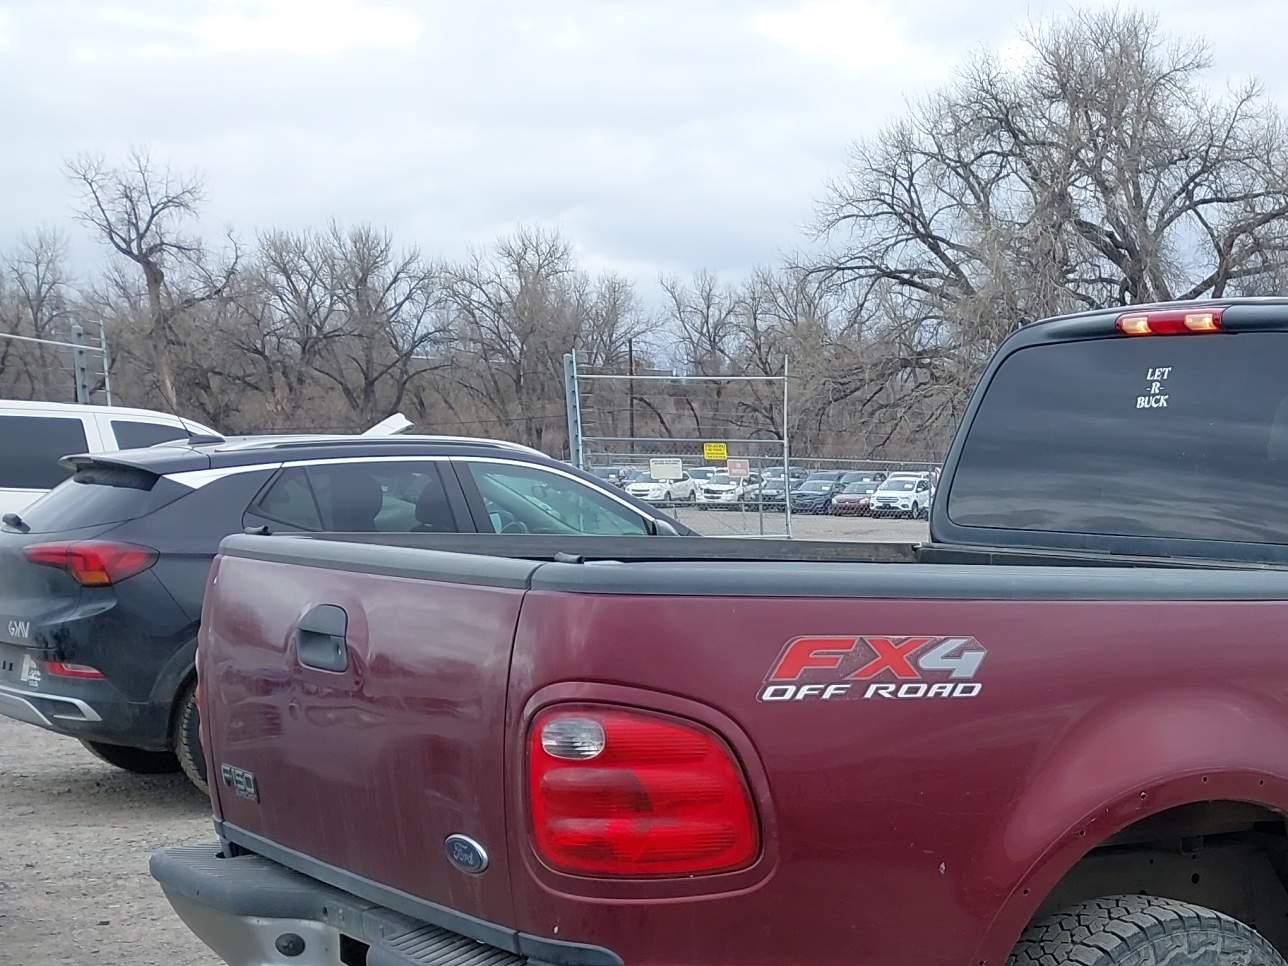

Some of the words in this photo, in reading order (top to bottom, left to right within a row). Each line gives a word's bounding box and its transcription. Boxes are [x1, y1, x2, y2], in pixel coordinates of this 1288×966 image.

[1146, 367, 1172, 380] LET
[1136, 395, 1169, 409] BUCK
[769, 638, 986, 681] FX4
[762, 684, 852, 701] OFF
[863, 683, 982, 699] ROAD
[453, 842, 475, 865] Ford
